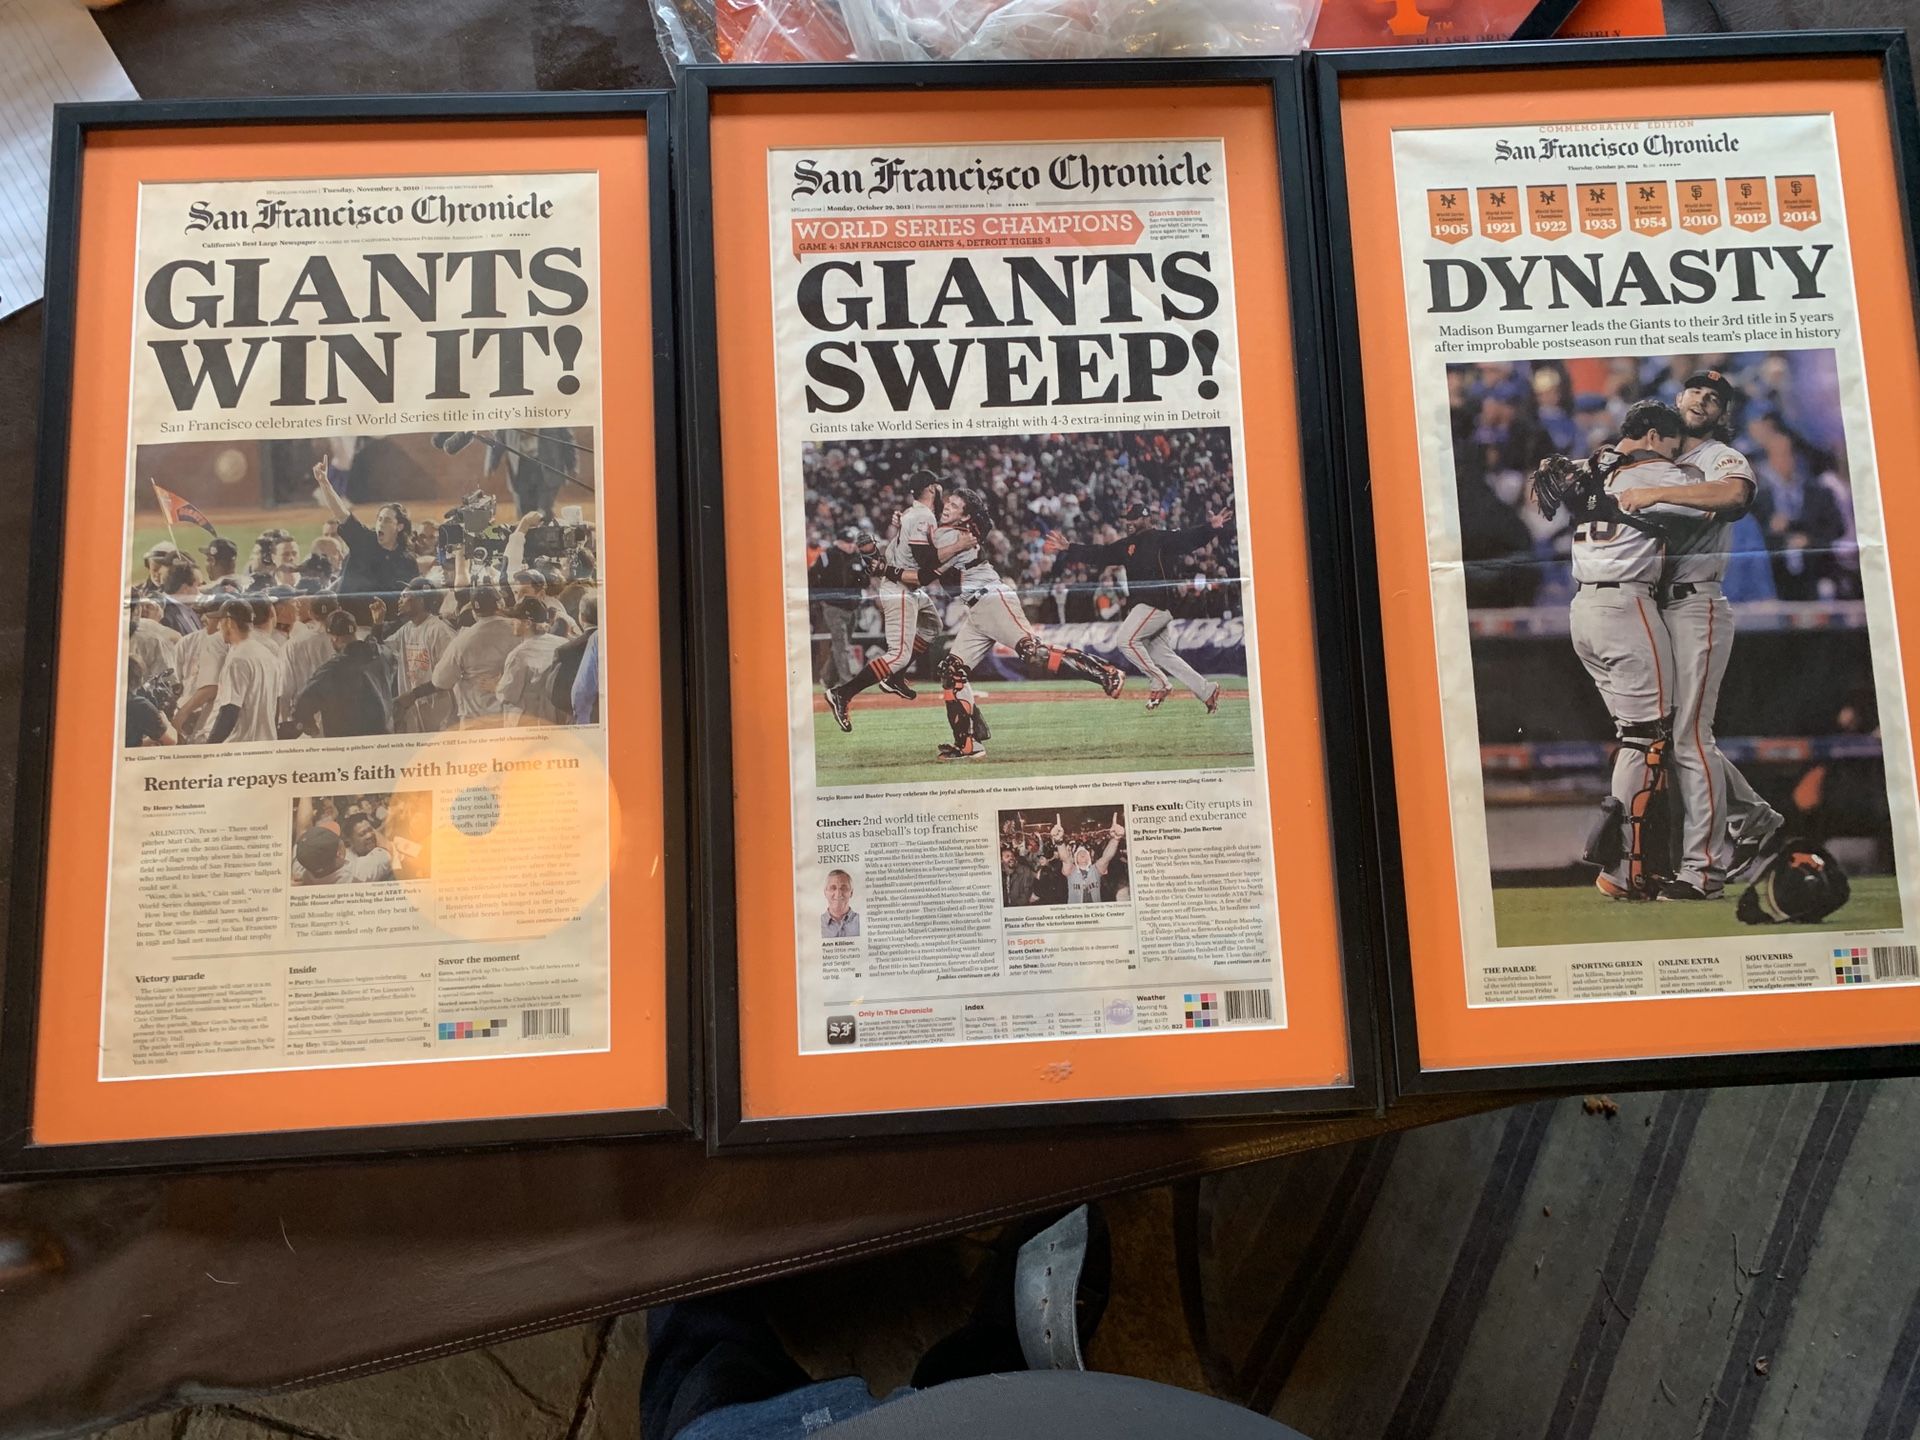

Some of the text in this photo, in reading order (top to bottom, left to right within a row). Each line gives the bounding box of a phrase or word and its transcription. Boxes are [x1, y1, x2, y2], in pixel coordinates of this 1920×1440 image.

[1539, 120, 1694, 133] COMMEMORATIVE EDITION
[1494, 132, 1740, 164] San Francisco Chronicle
[791, 152, 1212, 201] San Francisco Chronicle
[185, 192, 553, 235] San Francisco Chronicle
[1734, 213, 1767, 224] 2012
[1783, 211, 1817, 223] 2014
[795, 221, 888, 240] WORLD
[895, 218, 975, 237] SERIES
[982, 213, 1133, 236] CHAMPIONS
[1535, 221, 1567, 232] 1922
[1584, 219, 1617, 231] 1933
[1634, 217, 1667, 228] 1954
[1683, 215, 1718, 227] 2010
[1434, 224, 1469, 235] 1905
[1486, 223, 1516, 234] 1921
[202, 241, 241, 249] California's
[259, 240, 278, 248] Large
[799, 243, 827, 251] GAME
[840, 241, 859, 250] SAN
[861, 240, 916, 249] FRANCISCO
[919, 240, 954, 248] GIANTS
[956, 239, 965, 248] 4,
[967, 238, 1008, 247] DETROIT
[1010, 238, 1044, 246] TIGERS
[1423, 244, 1833, 314] DYNASTY
[144, 247, 589, 330] GIANTS
[797, 251, 1219, 332] GIANTS
[1439, 312, 1834, 337] Madison Bumgarner leads the Giants to their 3rd title in 5 years
[1434, 327, 1841, 353] after improbable postseason run that seals team's place in history
[147, 325, 583, 411] WIN IT!
[805, 329, 1220, 414] SWEEP!
[160, 406, 571, 433] San Francisco celebrates first World Series title in city's history
[810, 409, 1220, 434] Giants take World Series in 4 straight with 4-3 extra-inning win in Detroit
[144, 758, 579, 792] Renteria repays team's faith with huge home run
[1132, 799, 1252, 812] Fans exult: City erupts in
[816, 812, 979, 827] Clincher: 2nd world title cements
[1133, 811, 1247, 825] orange and exuberance
[817, 830, 847, 839] status
[863, 826, 911, 837] baseball's
[913, 825, 930, 836] top
[931, 823, 978, 834] franchise
[817, 844, 850, 853] BRUCE
[818, 854, 859, 864] JENKINS
[1017, 938, 1045, 946] Sports
[438, 954, 520, 966] Savor the moment
[1658, 957, 1720, 967] ONLINE EXTRA
[1745, 953, 1793, 961] SOUVENIRS
[289, 965, 317, 974] Inside
[1502, 965, 1536, 973] PARADE
[1571, 960, 1643, 970] SPORTING GREEN
[135, 972, 205, 984] Victory parade
